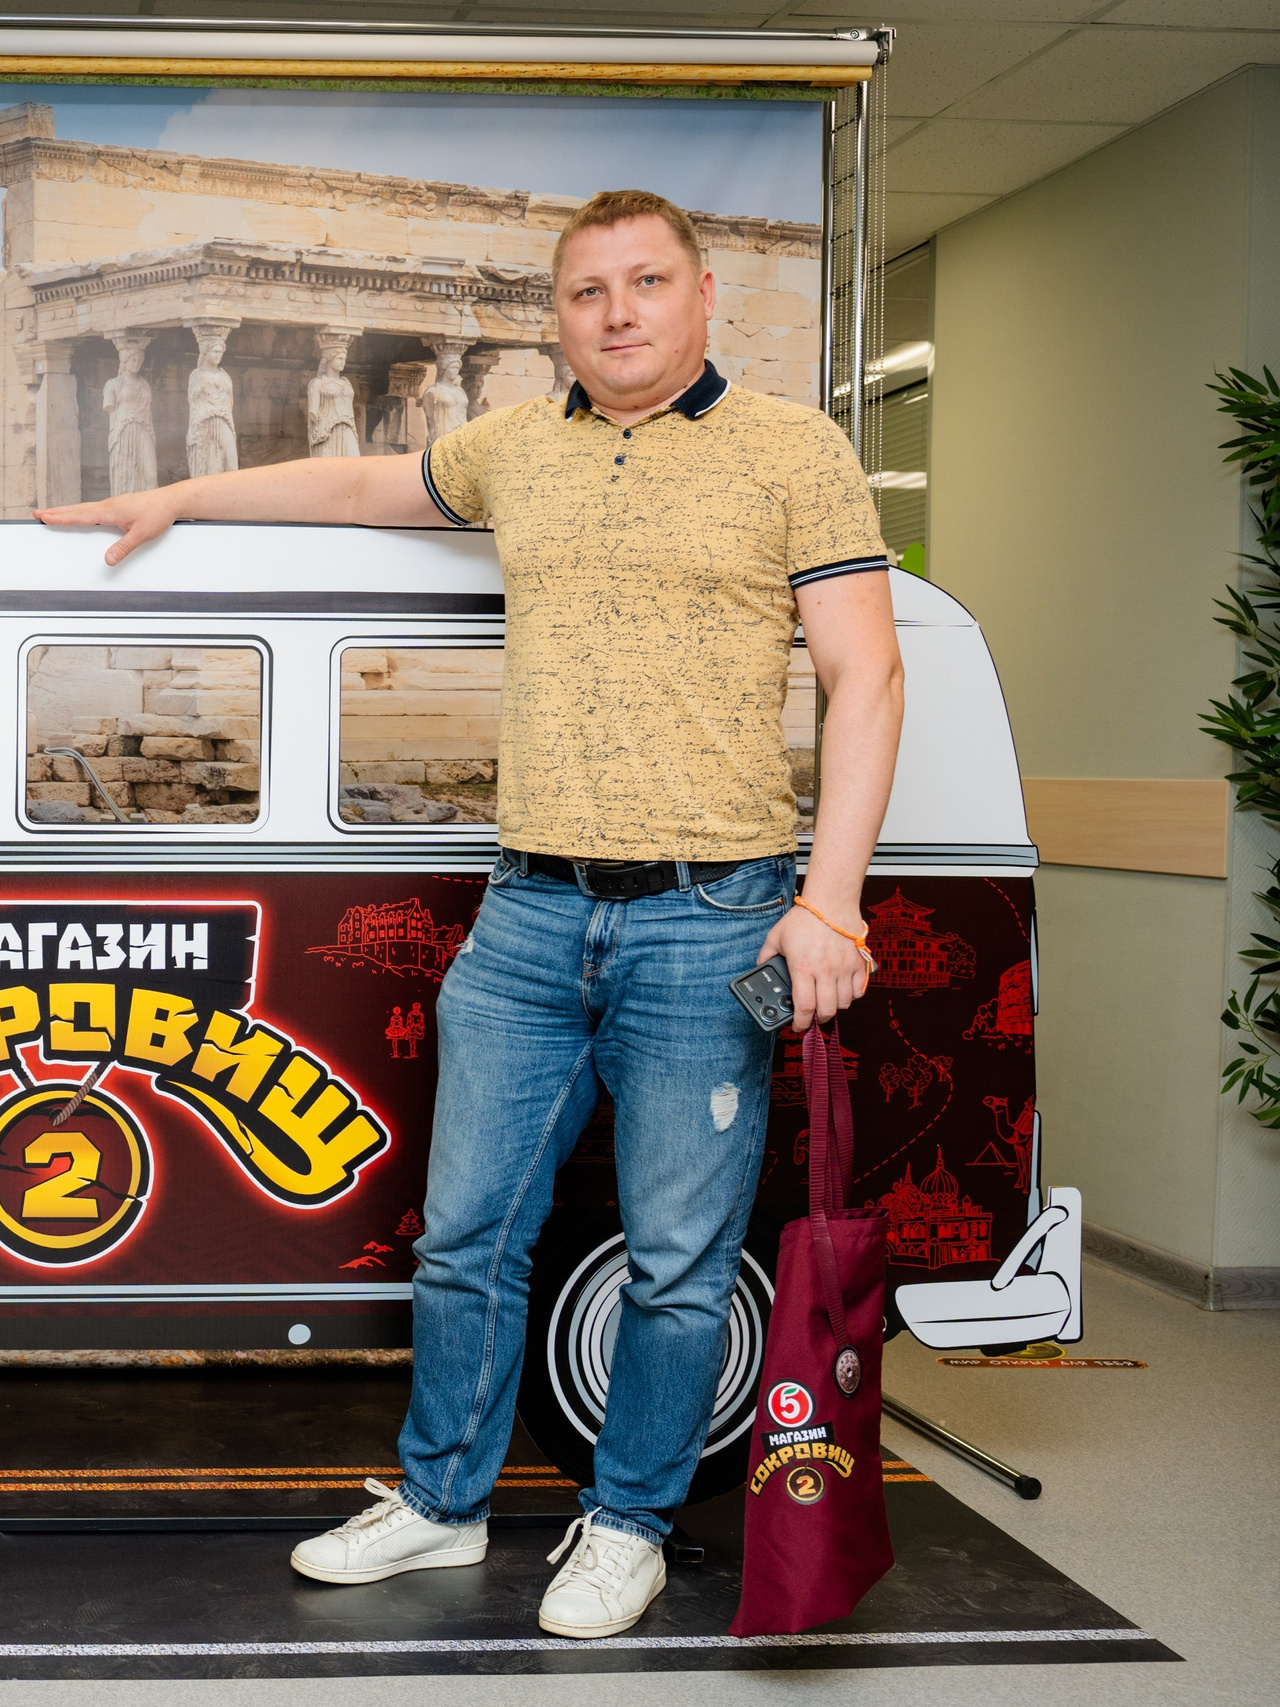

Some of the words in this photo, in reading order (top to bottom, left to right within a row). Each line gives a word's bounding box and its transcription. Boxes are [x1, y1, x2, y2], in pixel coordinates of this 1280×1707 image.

[21, 1131, 102, 1219] 2
[780, 1384, 801, 1420] 5
[769, 1427, 827, 1446] МАГАЗИН
[749, 1443, 855, 1496] СОКРОВИЩ
[796, 1475, 817, 1495] 2
